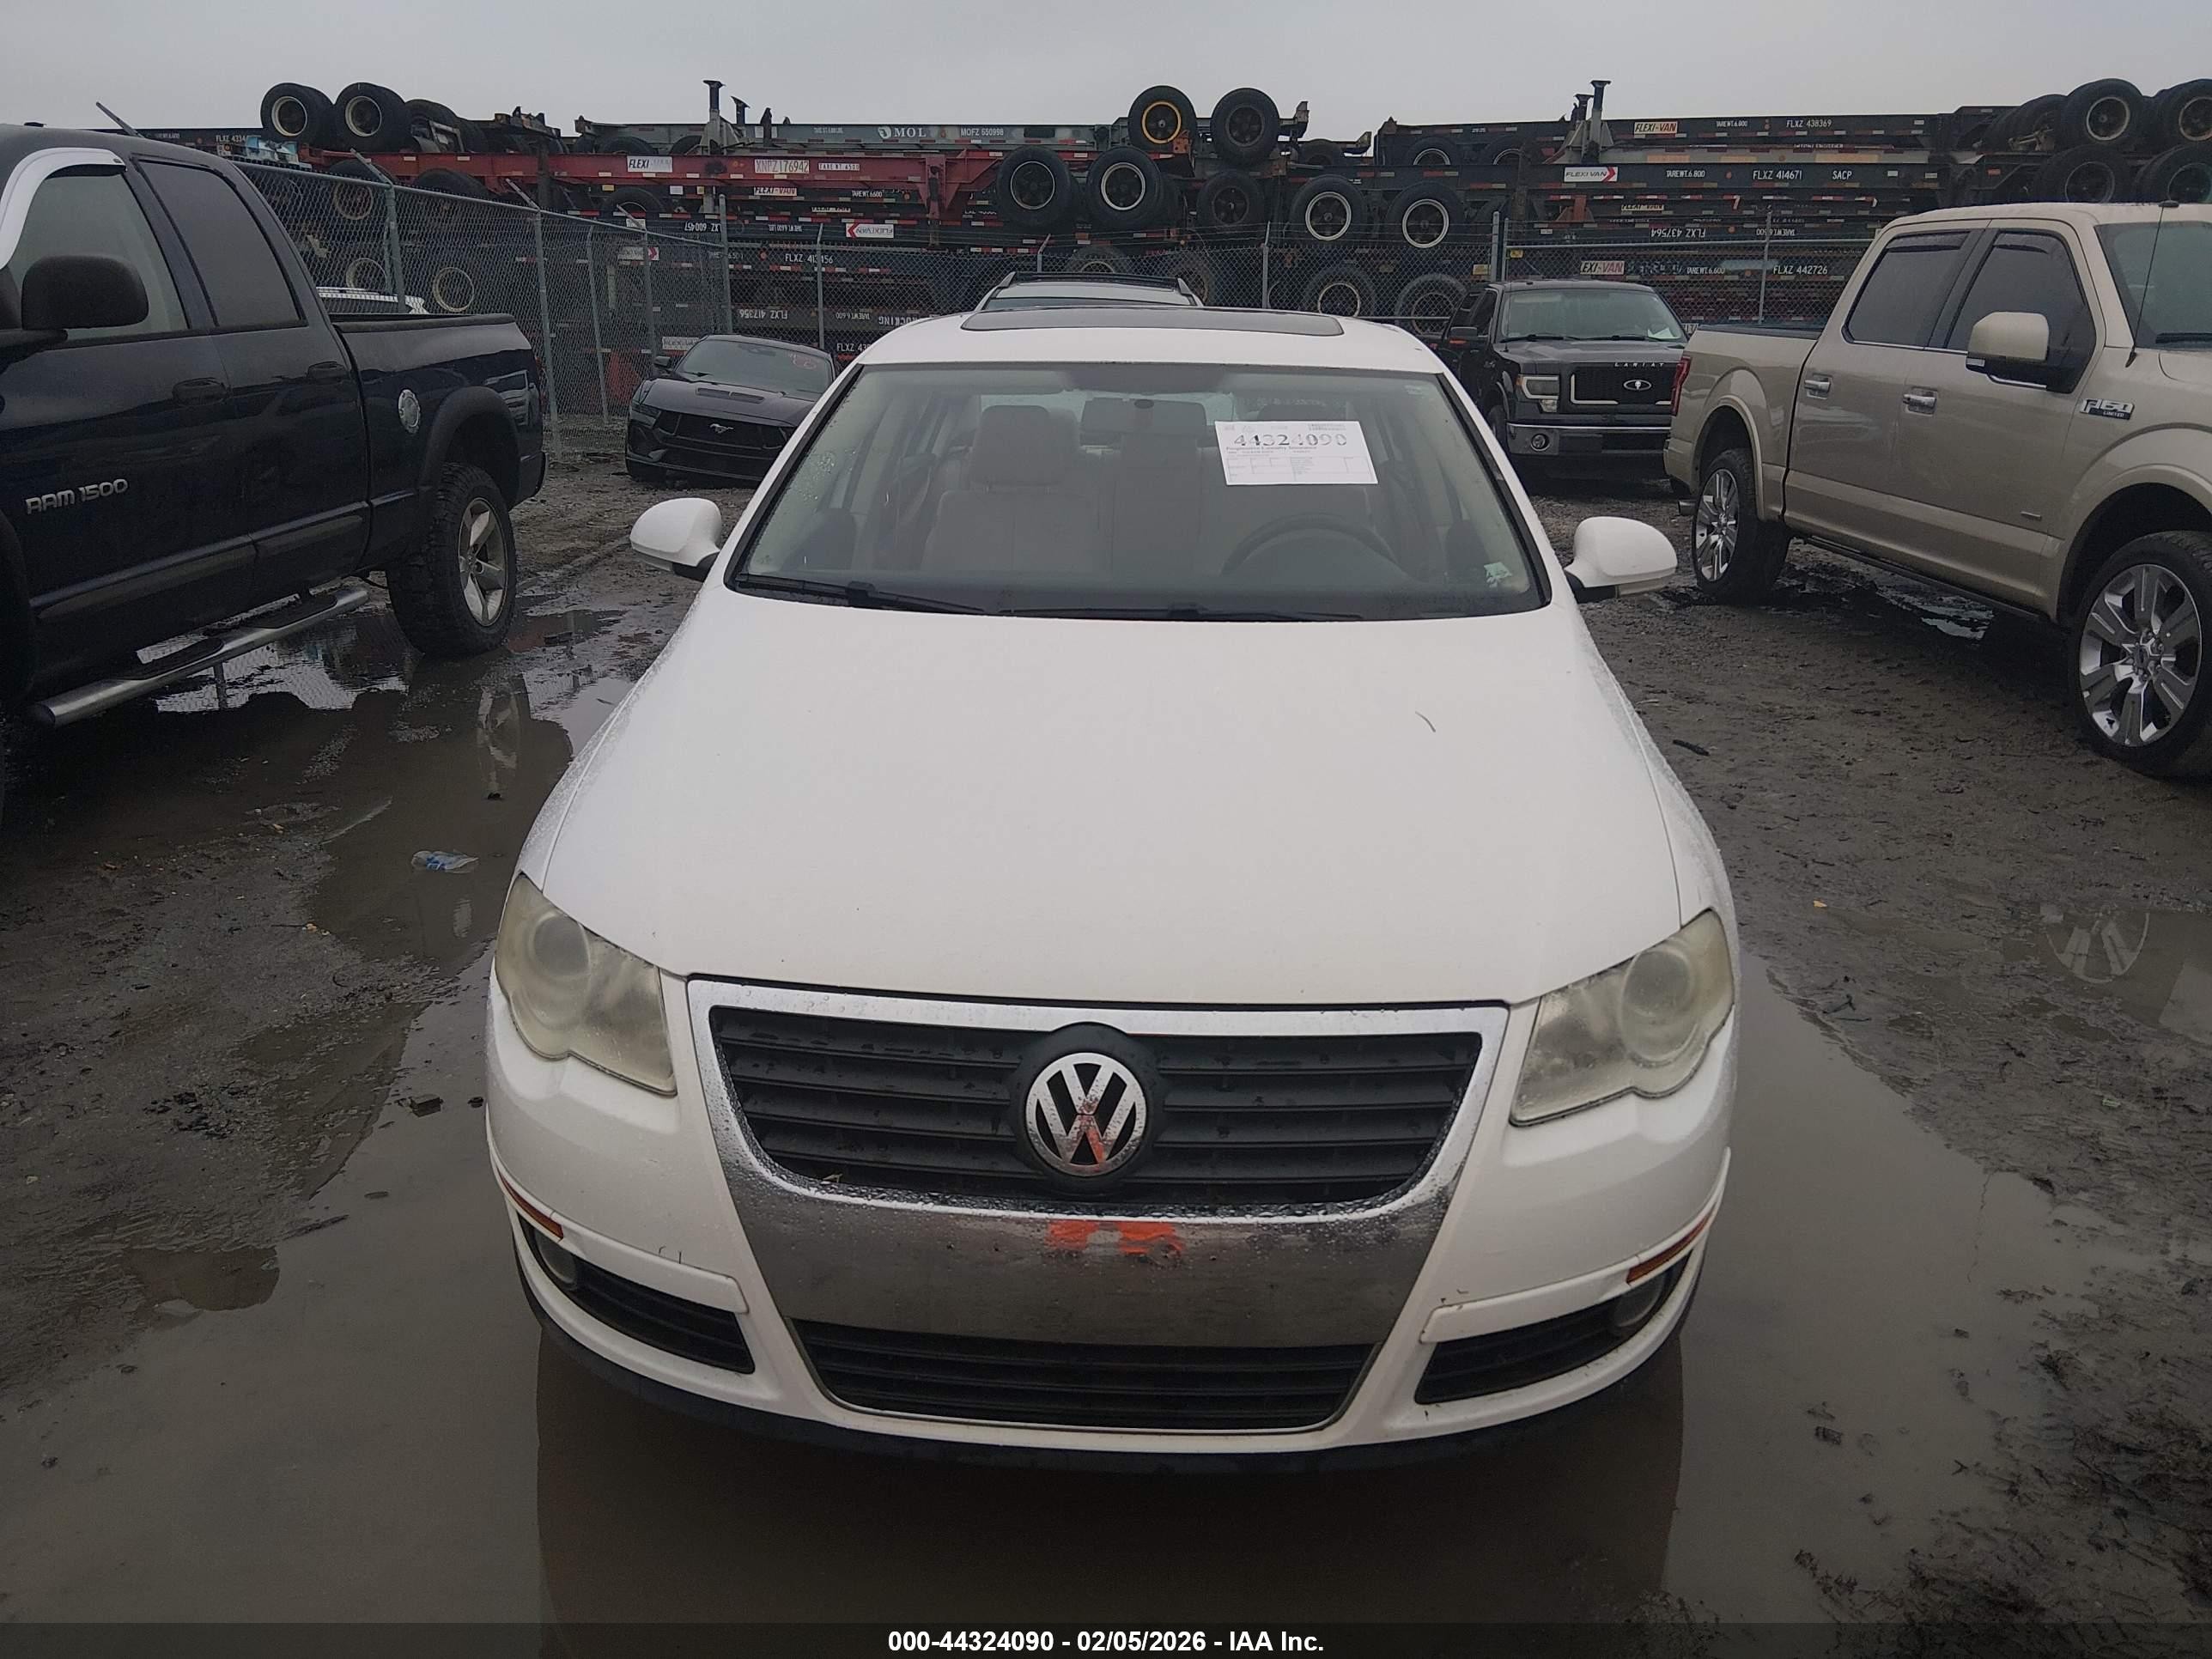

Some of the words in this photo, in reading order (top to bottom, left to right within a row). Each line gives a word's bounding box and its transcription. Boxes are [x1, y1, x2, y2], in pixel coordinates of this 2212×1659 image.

[1634, 122, 1677, 132] FLEXI-VAN
[1806, 119, 1832, 128] 438369
[894, 127, 927, 138] MOL
[960, 128, 980, 137] MOFZ
[232, 134, 246, 143] 4334
[629, 158, 649, 168] FLEXI
[1753, 170, 1773, 180] FLXZ
[1776, 170, 1802, 179] 414671
[1832, 170, 1852, 180] SACP
[711, 223, 722, 232] LXZ
[1686, 228, 1706, 238] FLXZ
[785, 253, 804, 263] FLXZ
[1773, 265, 1794, 275] FLXZ
[1796, 265, 1828, 275] 442726
[769, 309, 788, 319] FLXZ
[836, 343, 854, 352] FLXZ
[26, 489, 75, 515] RAM
[78, 478, 128, 502] 1500
